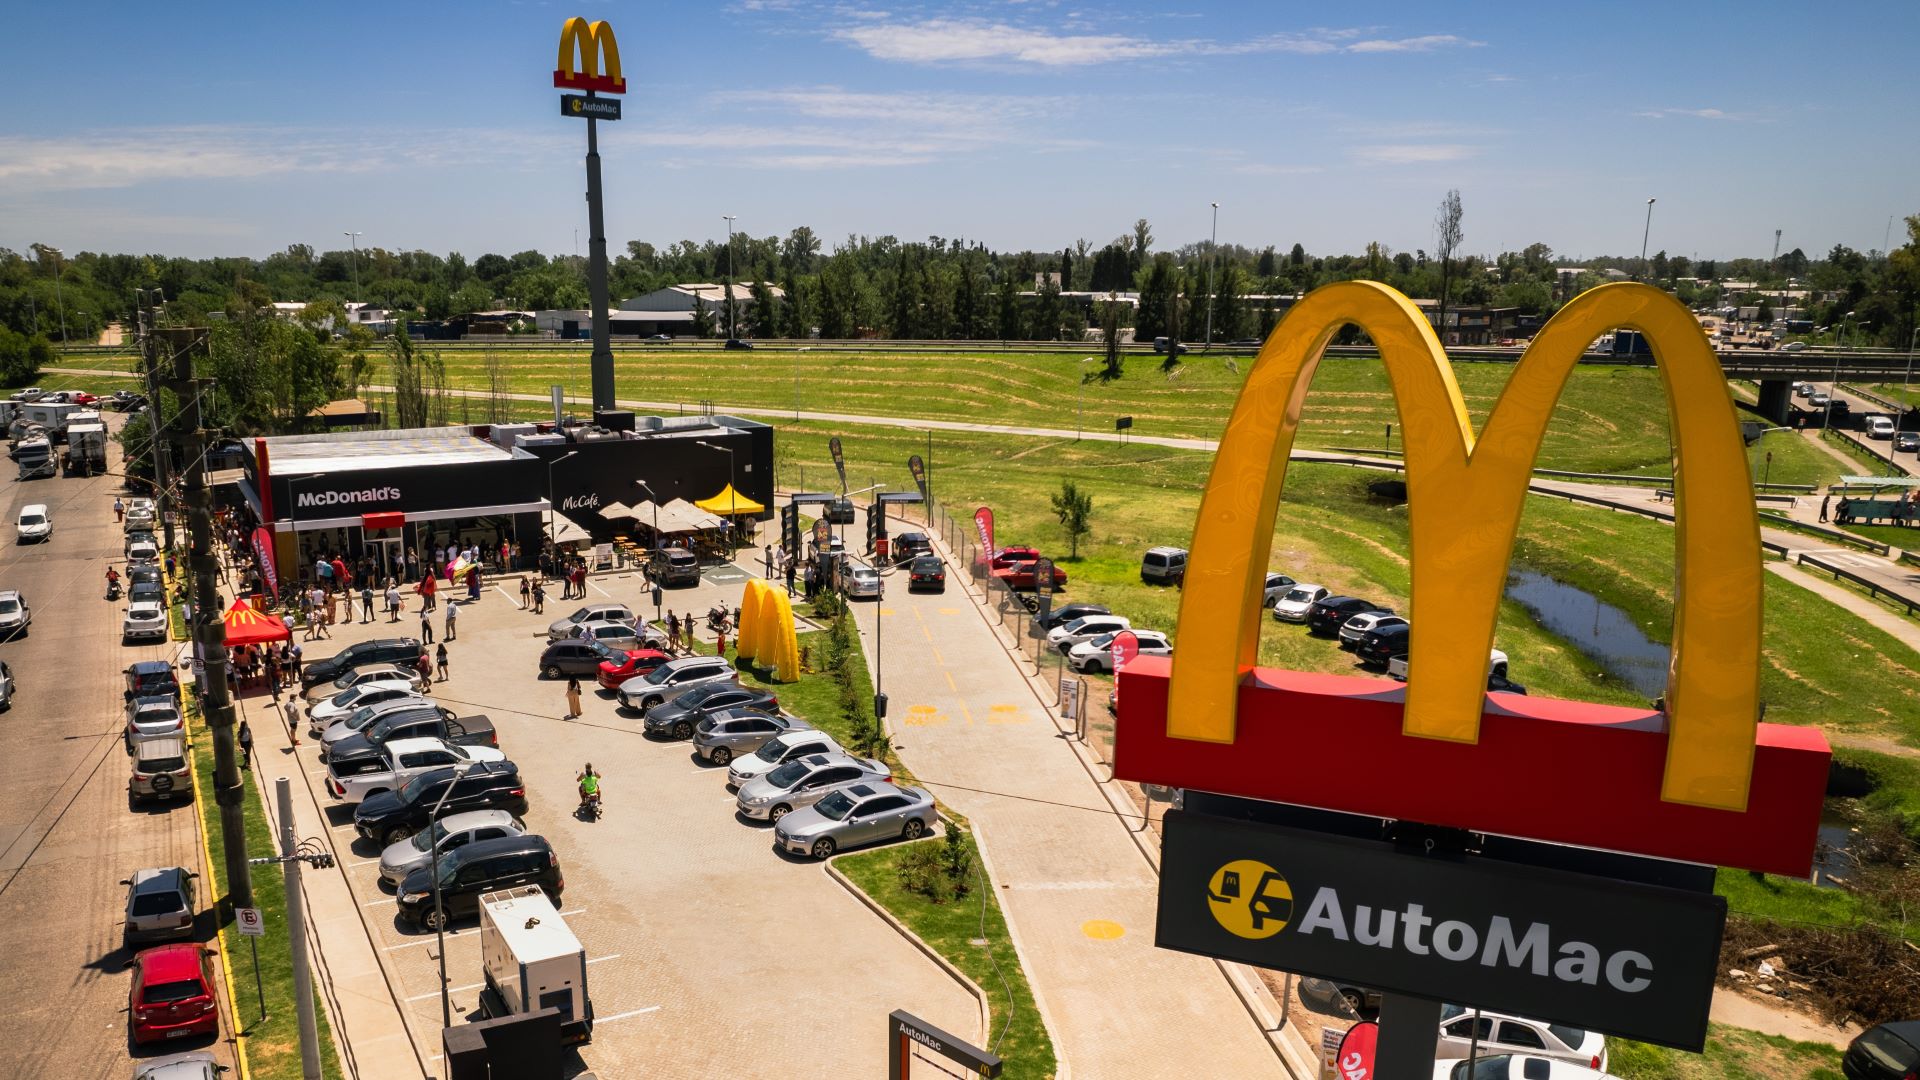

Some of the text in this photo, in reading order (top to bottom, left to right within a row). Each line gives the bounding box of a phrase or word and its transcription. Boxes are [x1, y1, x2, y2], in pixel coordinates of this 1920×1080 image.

[582, 101, 618, 114] AutoMac
[297, 486, 401, 507] McDonald's
[1297, 886, 1654, 994] AutoMac
[899, 1022, 942, 1052] AutoMac
